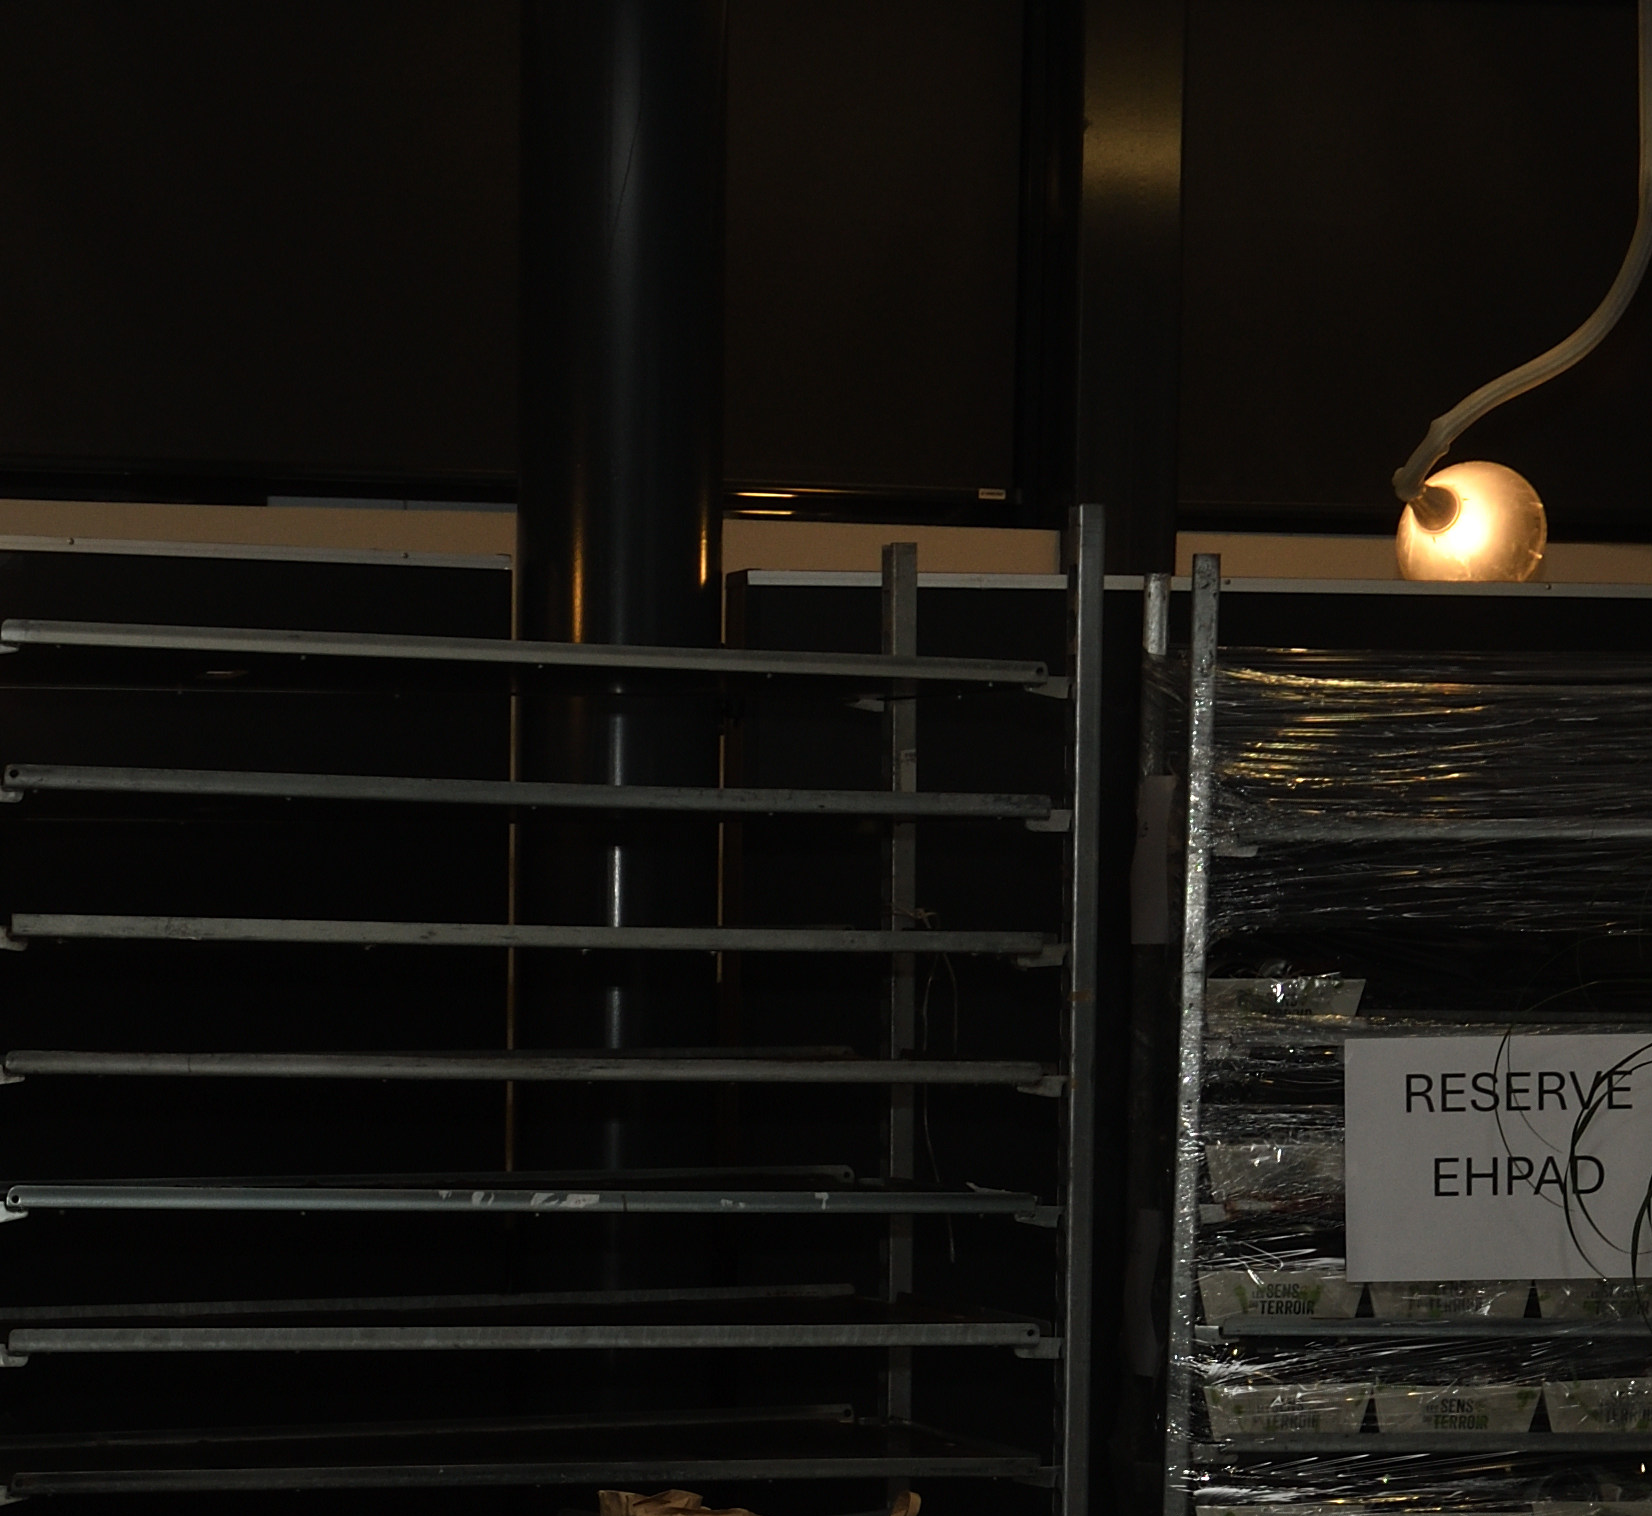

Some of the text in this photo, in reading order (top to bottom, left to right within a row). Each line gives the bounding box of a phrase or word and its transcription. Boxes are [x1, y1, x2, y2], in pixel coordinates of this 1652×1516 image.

[1405, 1070, 1634, 1113] RESERVE
[1433, 1155, 1606, 1197] EHPAD
[1266, 1284, 1300, 1299] SENS
[1260, 1301, 1315, 1315] TERROIR
[1441, 1399, 1474, 1413] SENS
[1434, 1415, 1488, 1429] TERROIR
